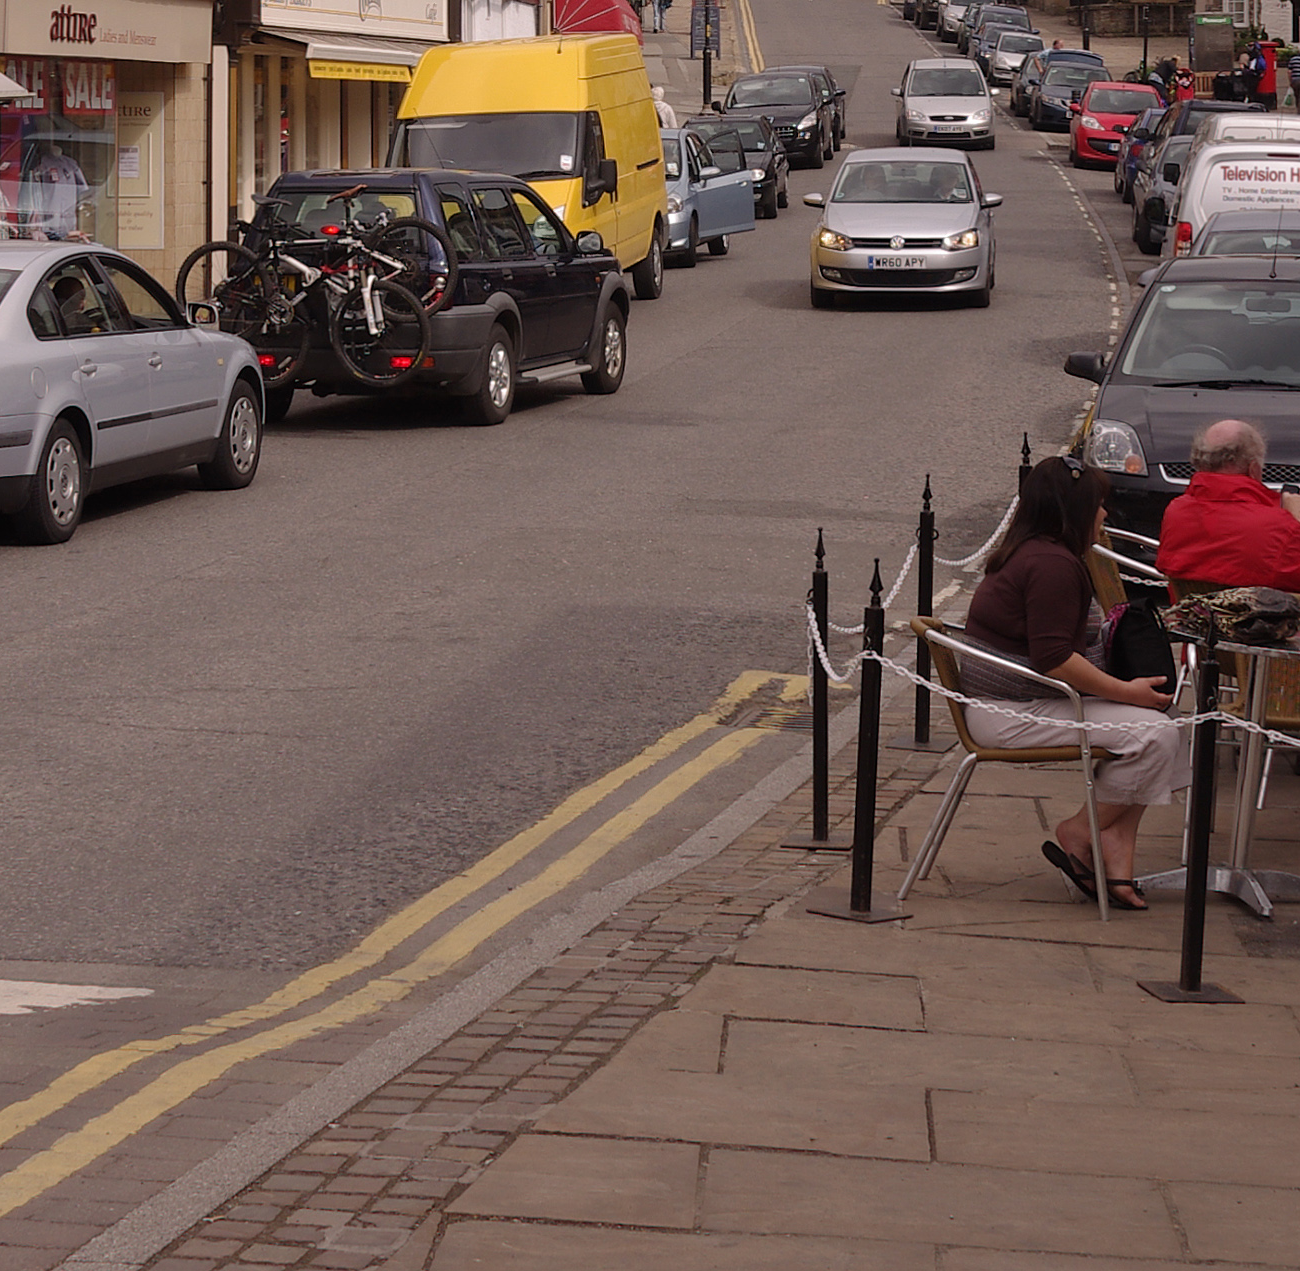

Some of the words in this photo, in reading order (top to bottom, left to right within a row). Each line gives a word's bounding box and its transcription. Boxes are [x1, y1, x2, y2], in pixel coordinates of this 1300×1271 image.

[3, 59, 44, 109] ALE
[65, 61, 114, 110] SALE
[1220, 166, 1286, 182] Television
[1238, 187, 1259, 195] Home
[1222, 195, 1254, 203] Domestic
[1257, 196, 1295, 205] Appliances
[874, 257, 902, 269] WR60
[904, 257, 925, 268] APY
